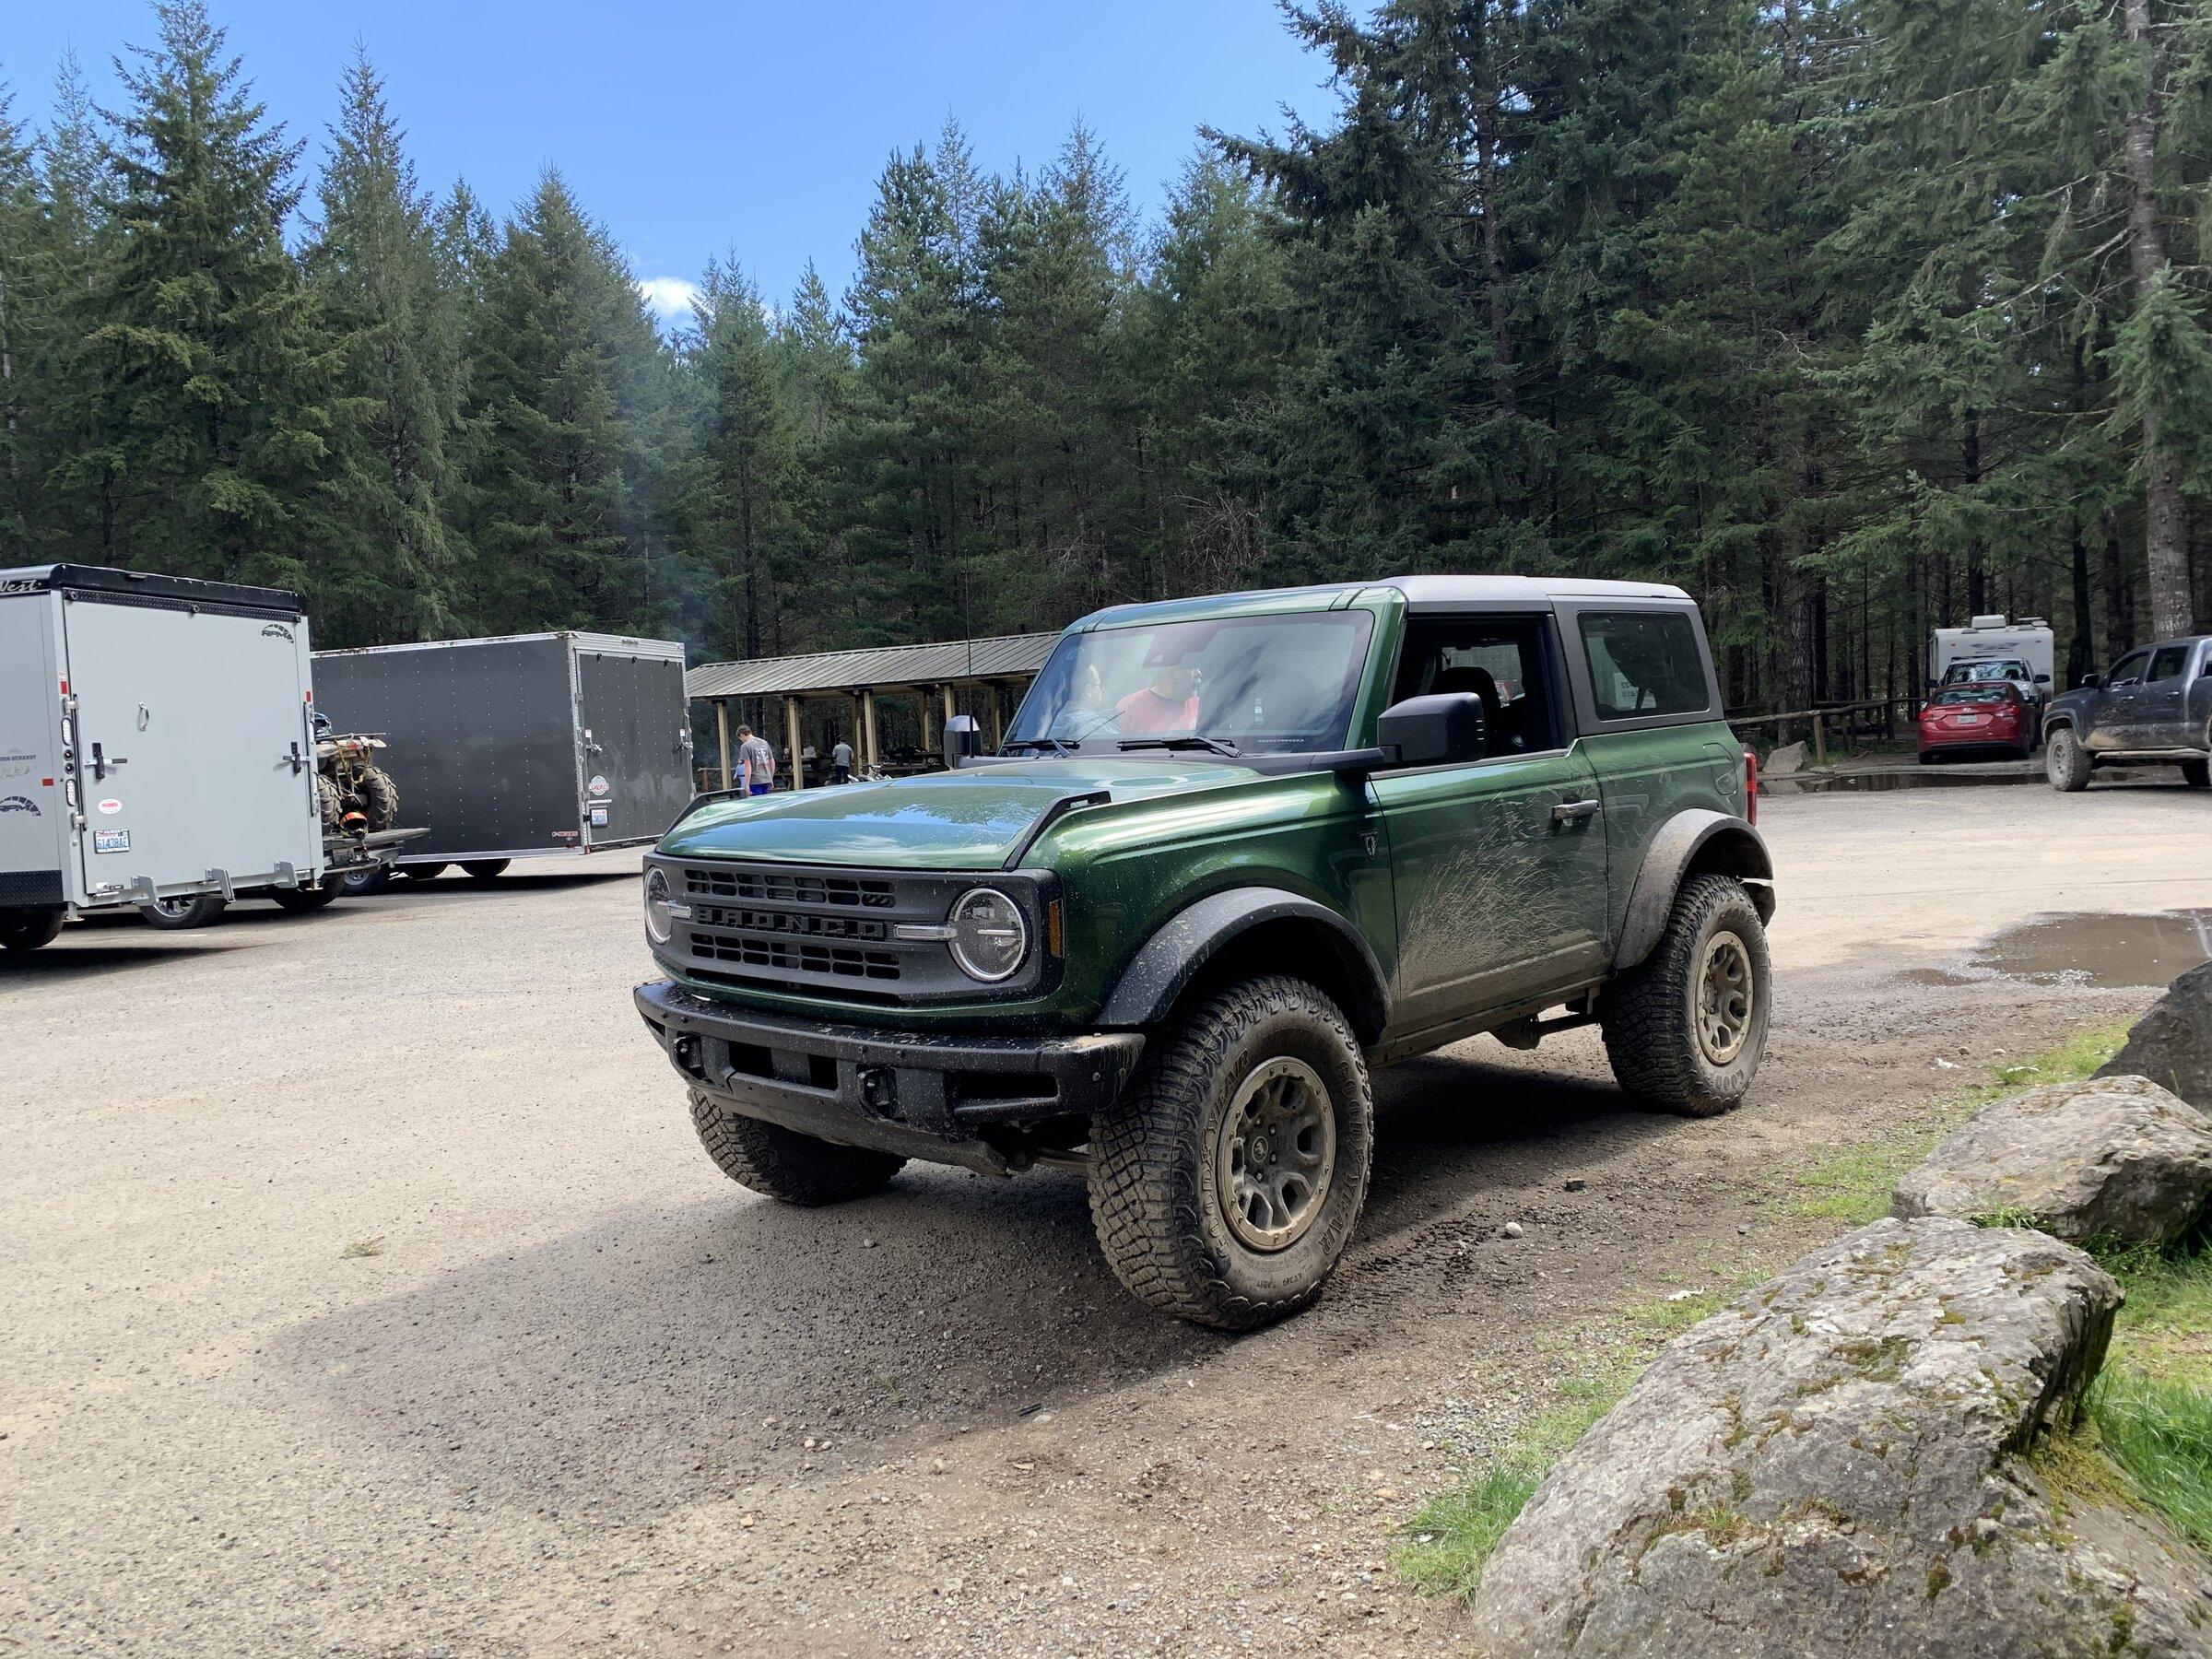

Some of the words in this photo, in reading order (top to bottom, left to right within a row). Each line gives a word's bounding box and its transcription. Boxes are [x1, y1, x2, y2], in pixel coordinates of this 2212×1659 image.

[697, 906, 886, 939] BRONCO
[1200, 1048, 1250, 1257] GOODYEAR
[1318, 1061, 1365, 1255] GOODYEAR
